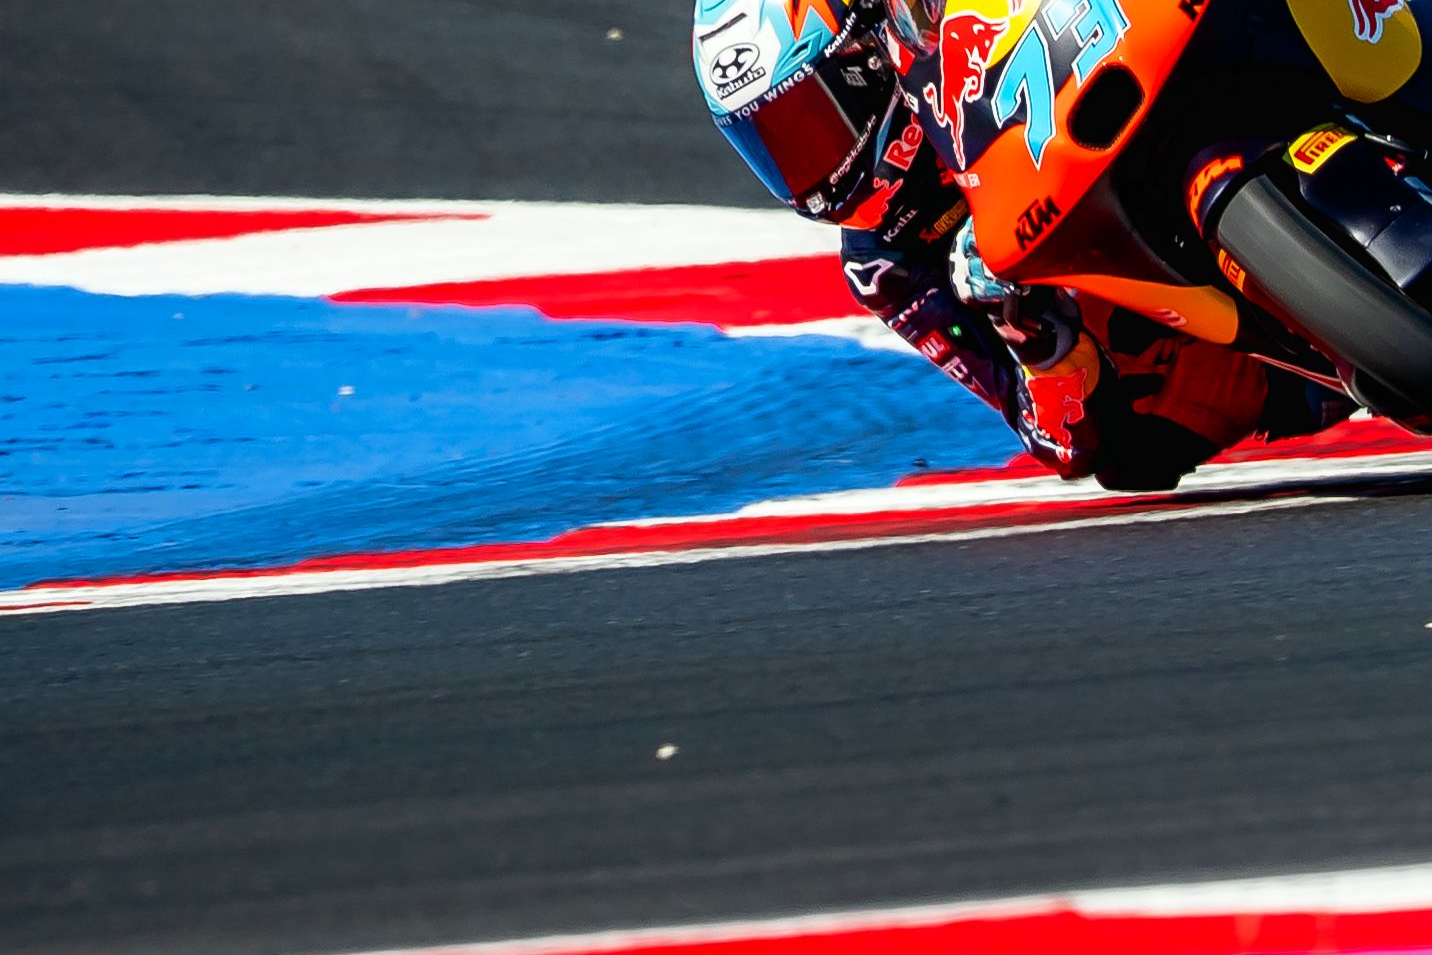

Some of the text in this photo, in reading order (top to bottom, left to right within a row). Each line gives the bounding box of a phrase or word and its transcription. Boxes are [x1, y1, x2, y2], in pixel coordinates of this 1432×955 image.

[734, 101, 760, 122] YOU
[763, 61, 816, 103] WINGS
[1013, 195, 1062, 252] KTM
